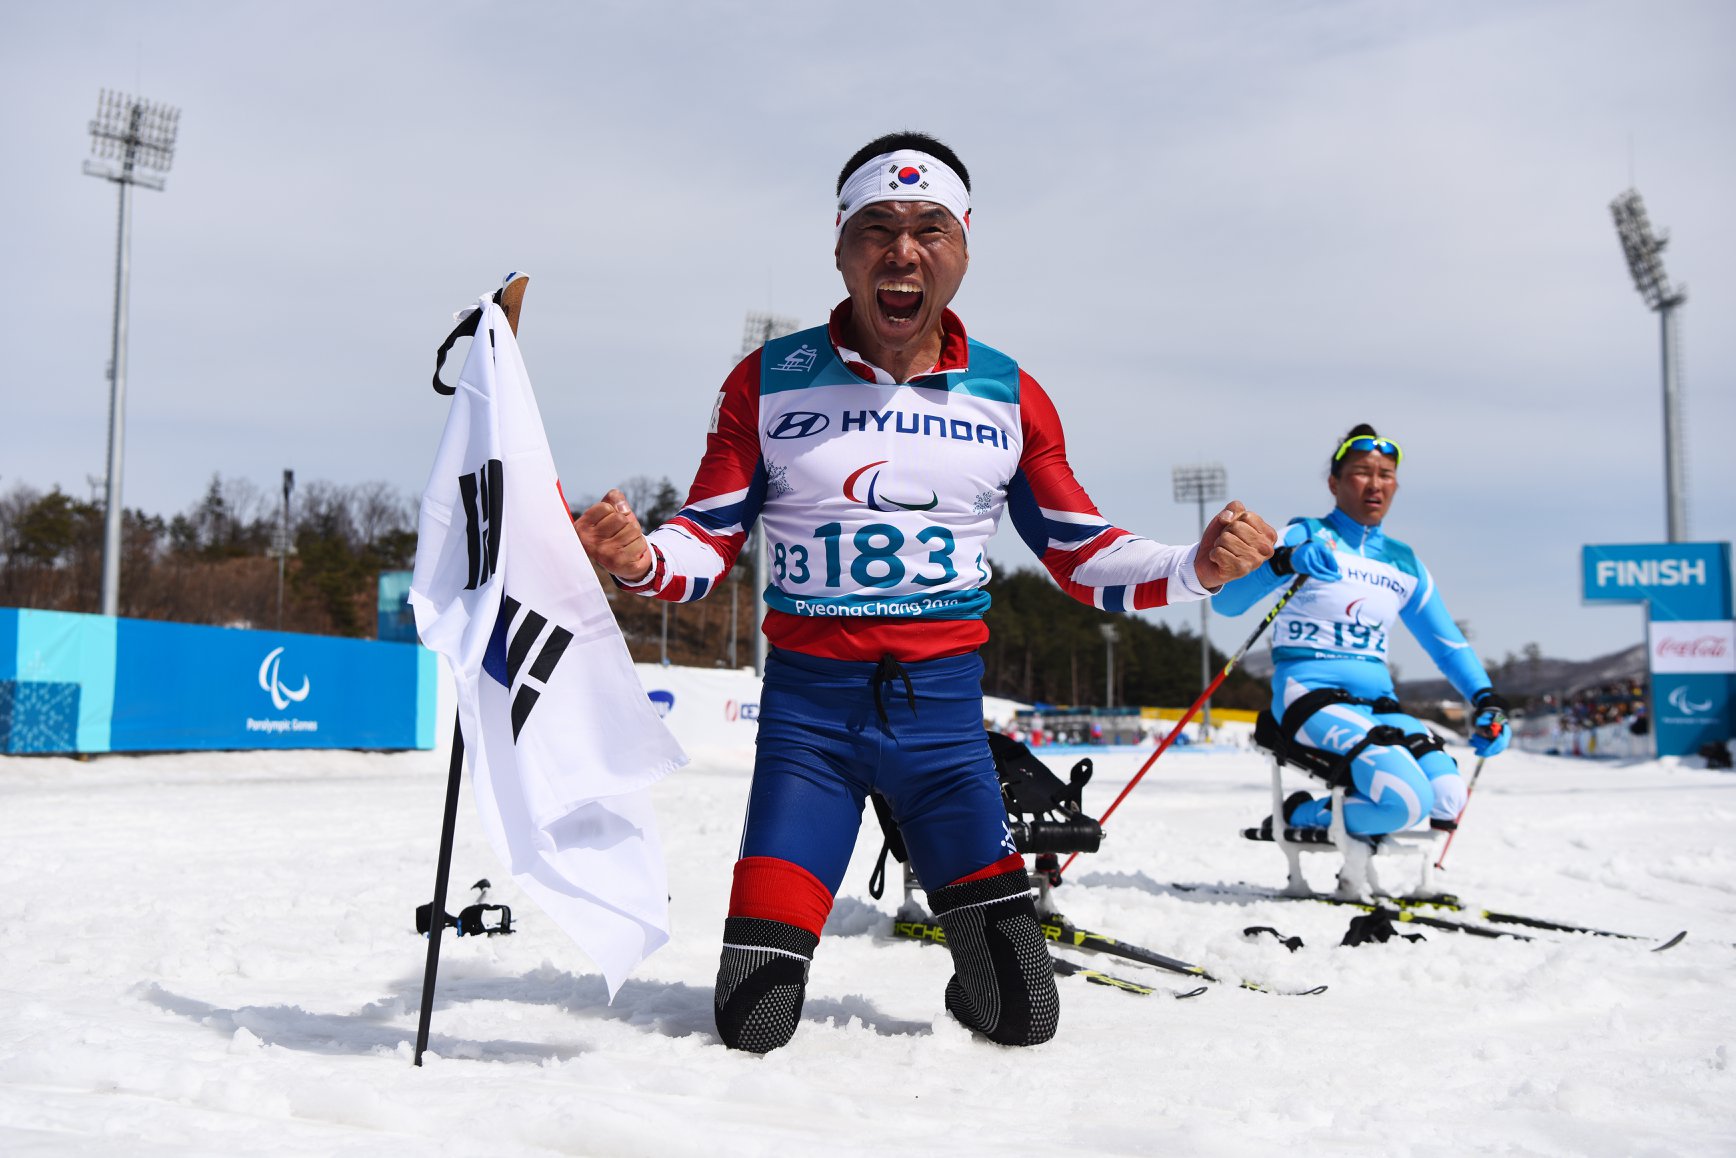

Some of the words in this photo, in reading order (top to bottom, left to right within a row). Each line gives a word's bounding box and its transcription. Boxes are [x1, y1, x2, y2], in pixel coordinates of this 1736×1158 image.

[841, 410, 1009, 451] HYUNDAI
[813, 522, 959, 589] 183
[1596, 559, 1706, 587] FINISH
[795, 600, 923, 617] PyeongChang
